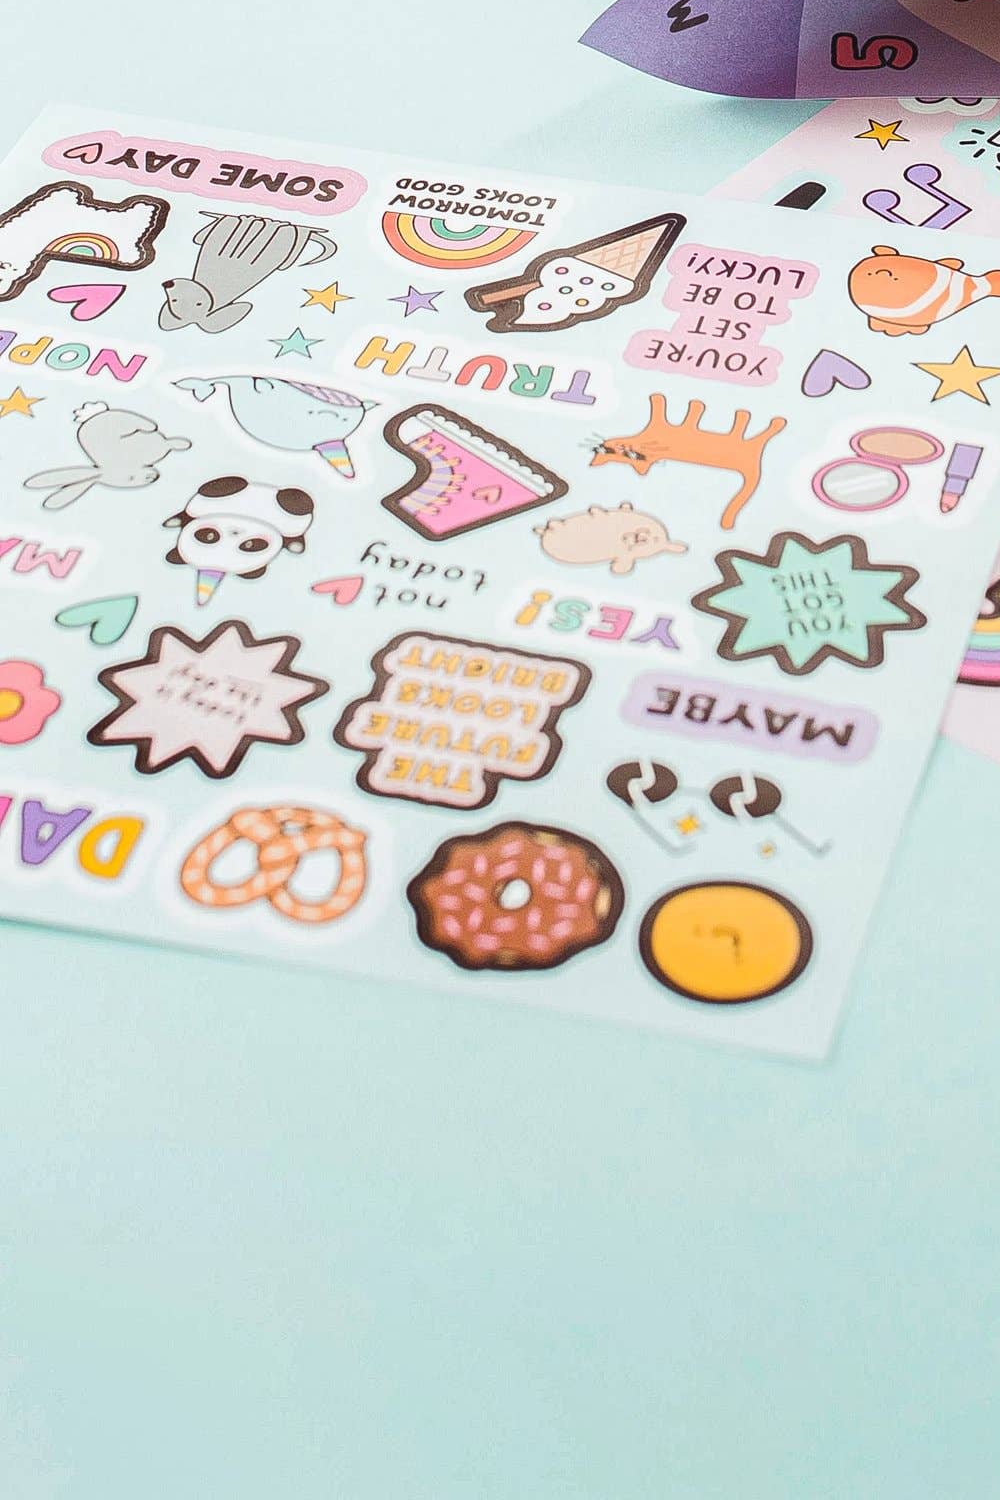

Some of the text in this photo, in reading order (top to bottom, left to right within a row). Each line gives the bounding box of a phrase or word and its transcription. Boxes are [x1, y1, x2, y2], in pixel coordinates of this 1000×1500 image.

[830, 32, 919, 72] 5
[106, 148, 345, 203] SOME DAY
[395, 176, 557, 210] LOOKS GOOD
[387, 193, 548, 227] TOMORROW
[687, 252, 806, 289] LUCKY!
[682, 284, 779, 316] TO BE
[687, 314, 753, 342] SET
[354, 334, 598, 406] TRUTH
[643, 338, 769, 376] YOU'RE
[360, 540, 487, 592] today
[771, 570, 836, 592] THIS
[374, 585, 449, 609] not
[783, 591, 843, 613] GOT
[514, 589, 681, 651] YES!
[787, 613, 854, 637] YOU
[399, 645, 569, 695] BRIGHT
[398, 682, 540, 726] LOOKS
[646, 686, 855, 748] MAYBE
[362, 711, 540, 764] FUTURE
[386, 756, 473, 793] THE
[0, 796, 145, 880] DA
